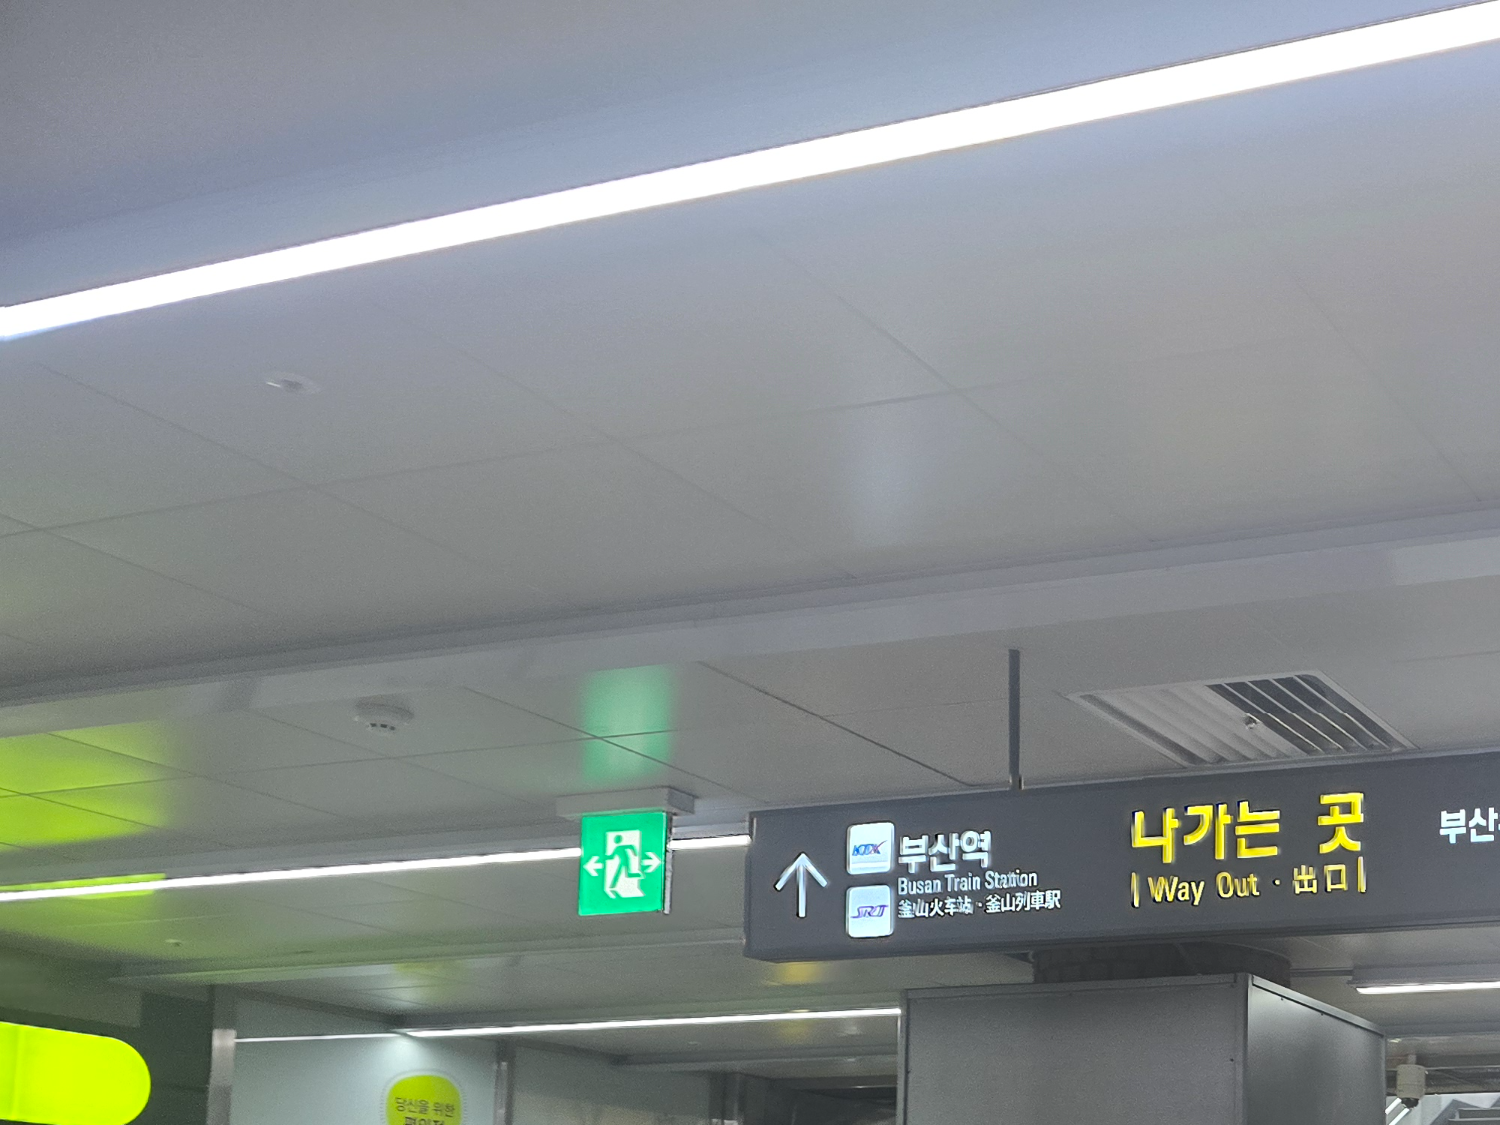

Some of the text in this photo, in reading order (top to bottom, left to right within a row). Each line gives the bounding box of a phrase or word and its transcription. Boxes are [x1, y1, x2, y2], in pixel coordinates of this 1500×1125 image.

[1131, 792, 1365, 864] 나가는 곳
[898, 830, 992, 874] 부산역
[897, 868, 1038, 896] Busan Train Station
[1147, 863, 1348, 906] Way Out 出口
[395, 1097, 455, 1117] 당신을 위한
